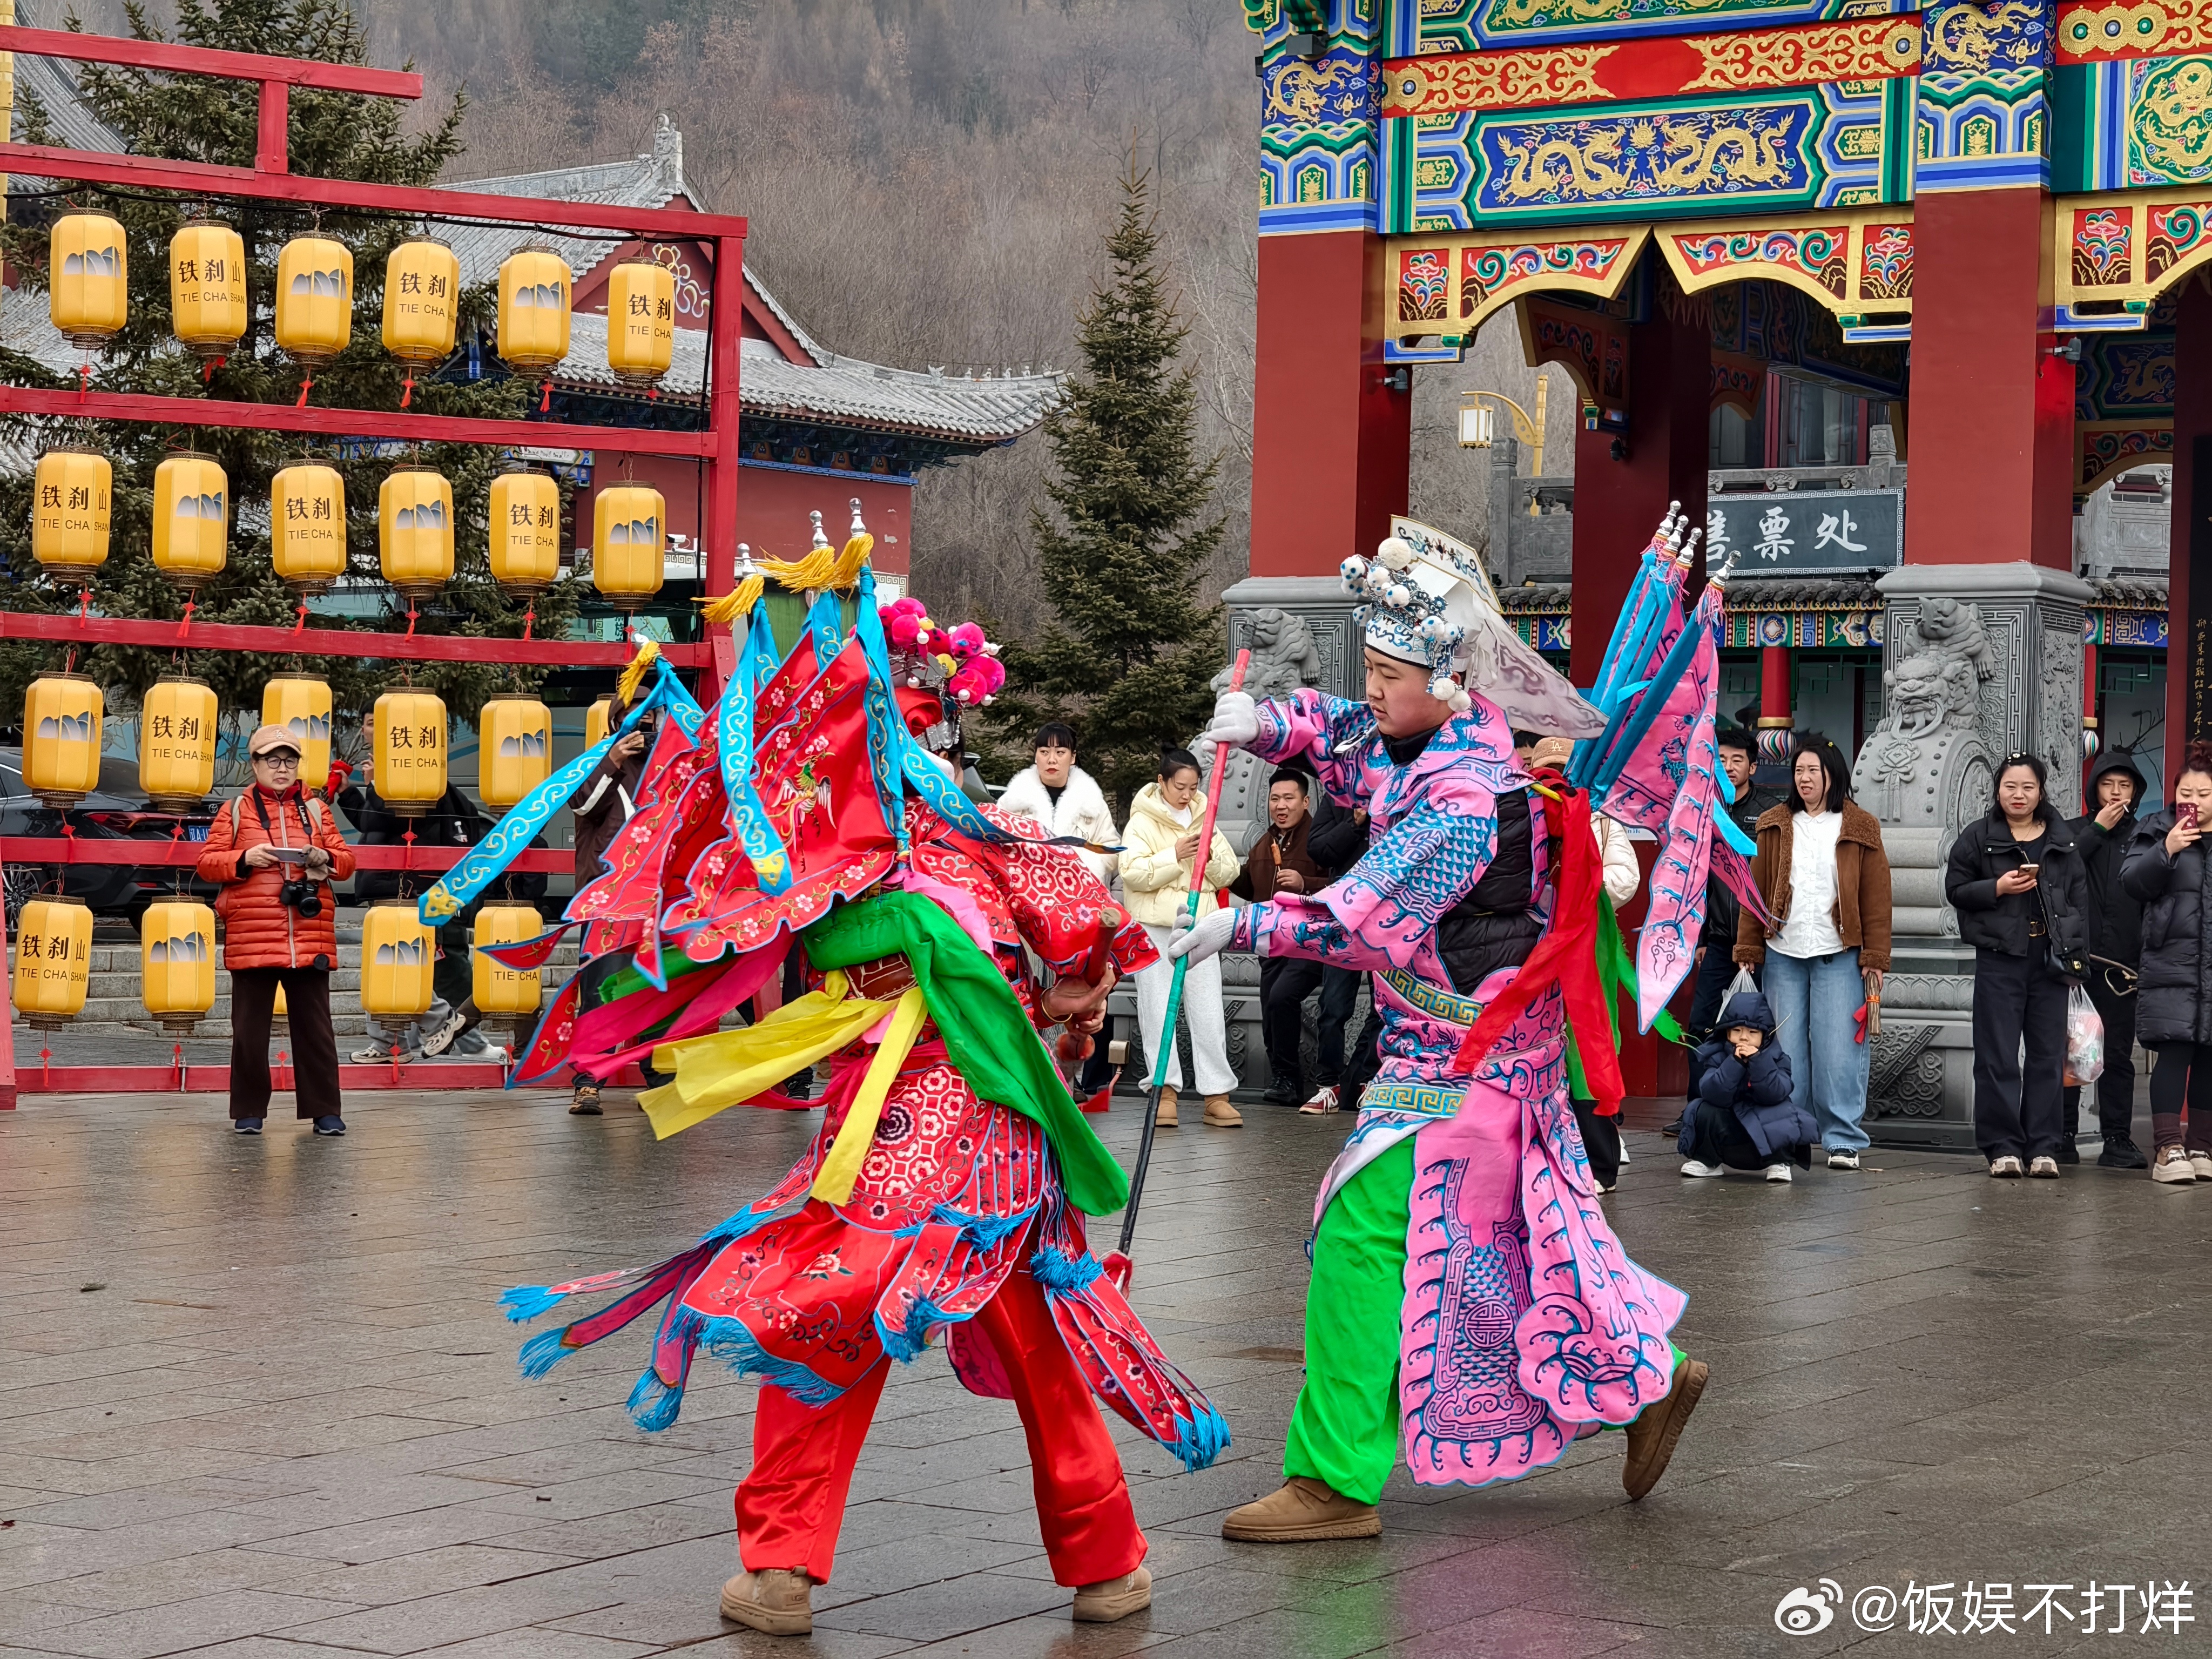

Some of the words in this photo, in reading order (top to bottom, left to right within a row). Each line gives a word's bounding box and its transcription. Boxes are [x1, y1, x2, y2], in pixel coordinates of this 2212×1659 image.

[178, 259, 240, 284] 铁刹山
[180, 292, 199, 303] TIE
[203, 292, 227, 301] CHA
[399, 304, 419, 313] TIE
[424, 304, 445, 317] CHA
[629, 294, 670, 321] 铁刹
[629, 325, 649, 335] TIE
[654, 328, 671, 340] CHA
[41, 485, 106, 511] 铁刹山
[510, 504, 553, 529] 铁刹
[41, 519, 59, 528] TIE
[65, 520, 90, 530] CHA
[94, 522, 109, 532] SHAN
[288, 530, 308, 539] TIE
[311, 529, 333, 539] CHA
[510, 536, 531, 544] TIE
[536, 536, 554, 547] CHA
[152, 716, 212, 743] 铁刹山
[1550, 740, 1562, 752] LA
[152, 748, 171, 758] TIE
[174, 749, 198, 760] CHA
[391, 758, 412, 767] TIE
[417, 758, 437, 767] CHA
[22, 934, 85, 961] 铁刹山
[21, 968, 37, 977] TIE
[43, 969, 68, 980] CHA
[71, 972, 86, 982] SHAN
[494, 971, 515, 980] TIE
[520, 971, 538, 981] CHA
